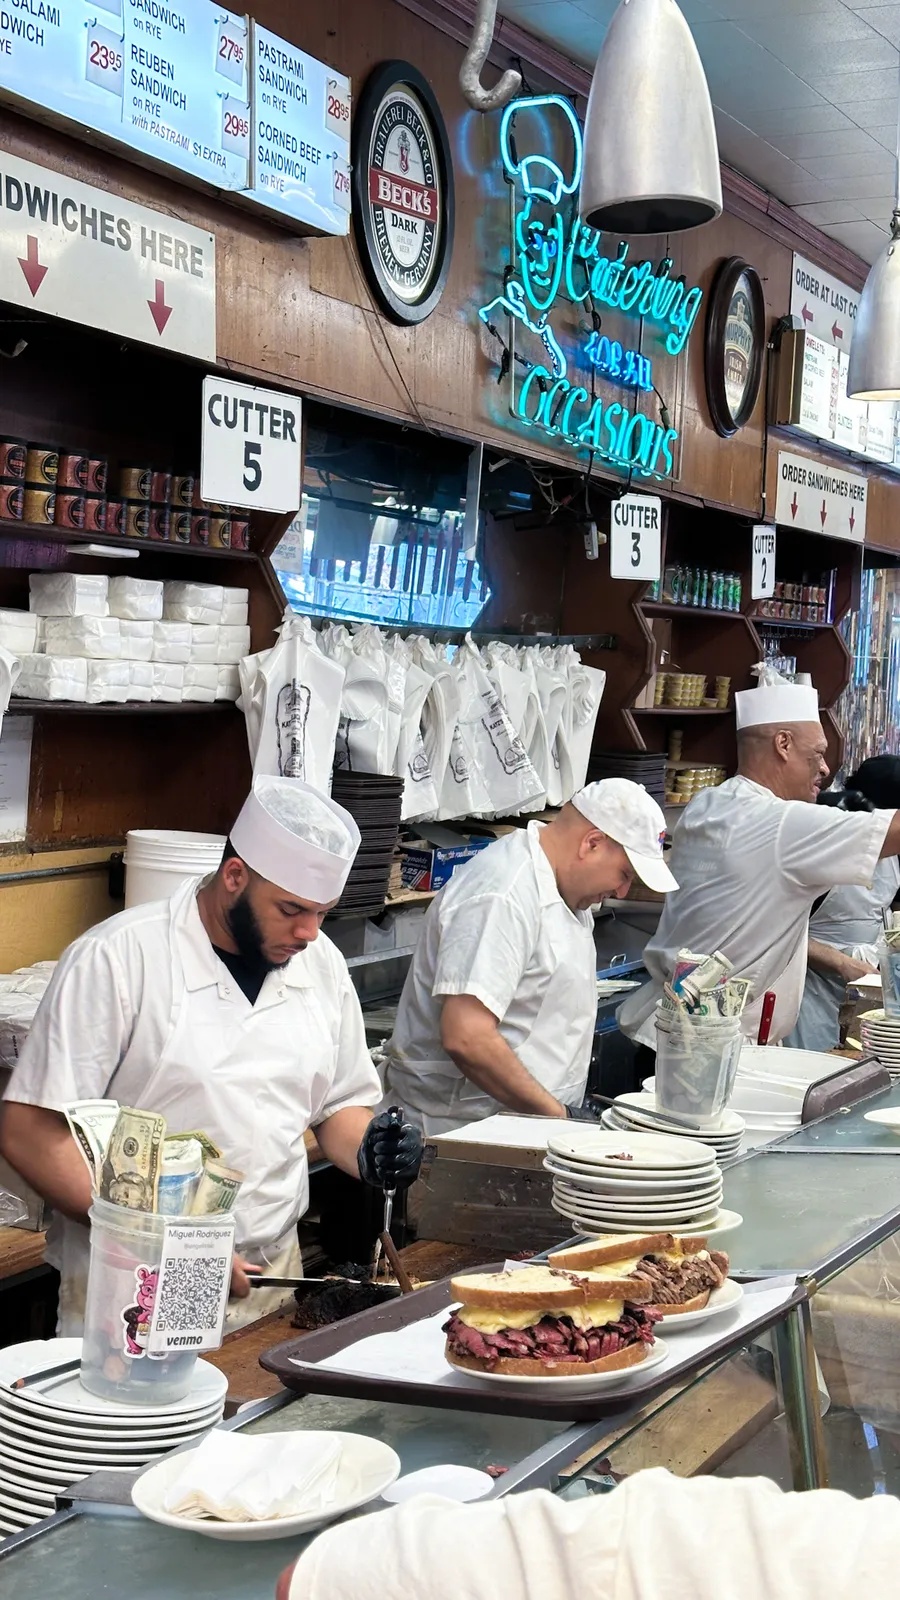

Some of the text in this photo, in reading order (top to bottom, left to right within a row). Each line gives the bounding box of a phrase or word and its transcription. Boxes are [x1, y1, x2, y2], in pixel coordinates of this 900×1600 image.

[133, 17, 162, 40] on RYE
[131, 43, 174, 81] REUBEN
[258, 39, 304, 80] PASTRAMI
[130, 68, 187, 110] SANDWICH
[258, 64, 308, 105] SANDWICH
[261, 92, 287, 114] on RYE
[132, 96, 161, 118] on RYE
[131, 114, 148, 131] with
[149, 121, 190, 151] PASTRAMI
[203, 146, 227, 169] EXTRA
[258, 121, 322, 166] CORNED BEEF
[374, 106, 404, 167] BRAUEREI
[406, 110, 427, 147] BECK
[257, 145, 307, 183] SANDWICH
[260, 172, 285, 193] on RYE
[0, 172, 204, 278] DWICHES HERE
[391, 213, 418, 235] DARK
[375, 210, 433, 286] BREMEN GERMANY
[795, 268, 820, 298] ORDER
[820, 284, 830, 303] AT
[831, 290, 848, 314] LAST
[208, 393, 297, 443] CUTTER
[243, 440, 263, 492] 5
[782, 463, 865, 502] ORDER SANDWICHES HERE
[614, 502, 659, 530] CUTTER
[630, 532, 642, 567] 3
[754, 534, 775, 554] CUTTER
[760, 557, 767, 589] 2
[168, 1229, 232, 1240] Miguel Rodriguez
[166, 1335, 203, 1346] venmo
